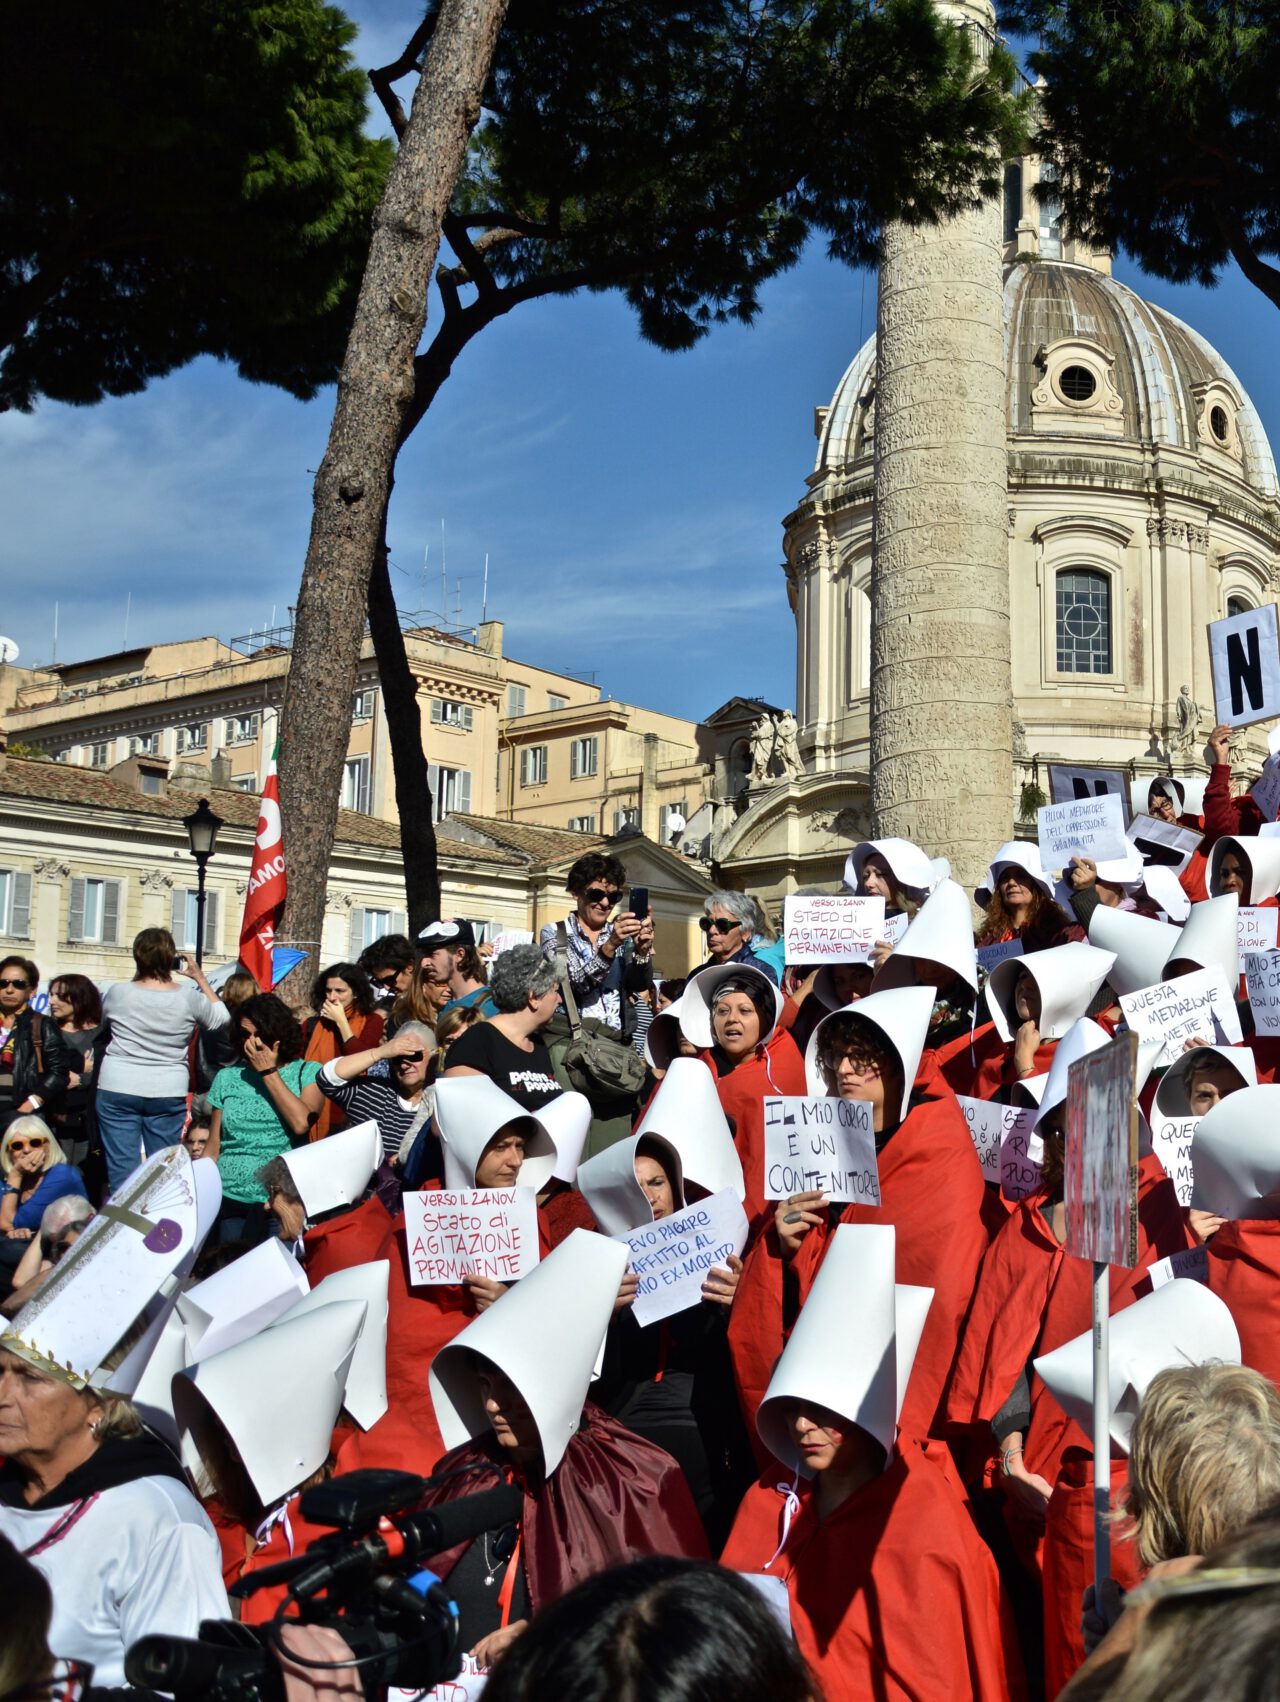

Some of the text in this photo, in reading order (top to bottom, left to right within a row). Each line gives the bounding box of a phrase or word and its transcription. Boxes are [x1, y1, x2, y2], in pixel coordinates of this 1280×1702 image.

[1226, 627, 1264, 716] N
[788, 927, 873, 941] AGITAZIONE
[1247, 921, 1259, 933] DI
[788, 941, 869, 955] PERMANENTE
[1247, 957, 1268, 972] MIO
[1127, 985, 1178, 1013] QUESTA
[1148, 987, 1218, 1025] MEDIAZIONE
[1250, 996, 1267, 1008] CON
[1163, 1018, 1201, 1042] METTE
[509, 1070, 549, 1085] potere
[837, 1100, 869, 1131] CORPO
[1003, 1110, 1028, 1131] SE
[810, 1134, 836, 1156] UN
[768, 1164, 880, 1198] CONTENITORE
[489, 1211, 508, 1229] di
[412, 1227, 521, 1256] AGITAZIONE
[626, 1232, 657, 1253] EVO
[694, 1233, 716, 1251] AL
[415, 1253, 521, 1281] PERMANENTE
[634, 1276, 658, 1299] MIO
